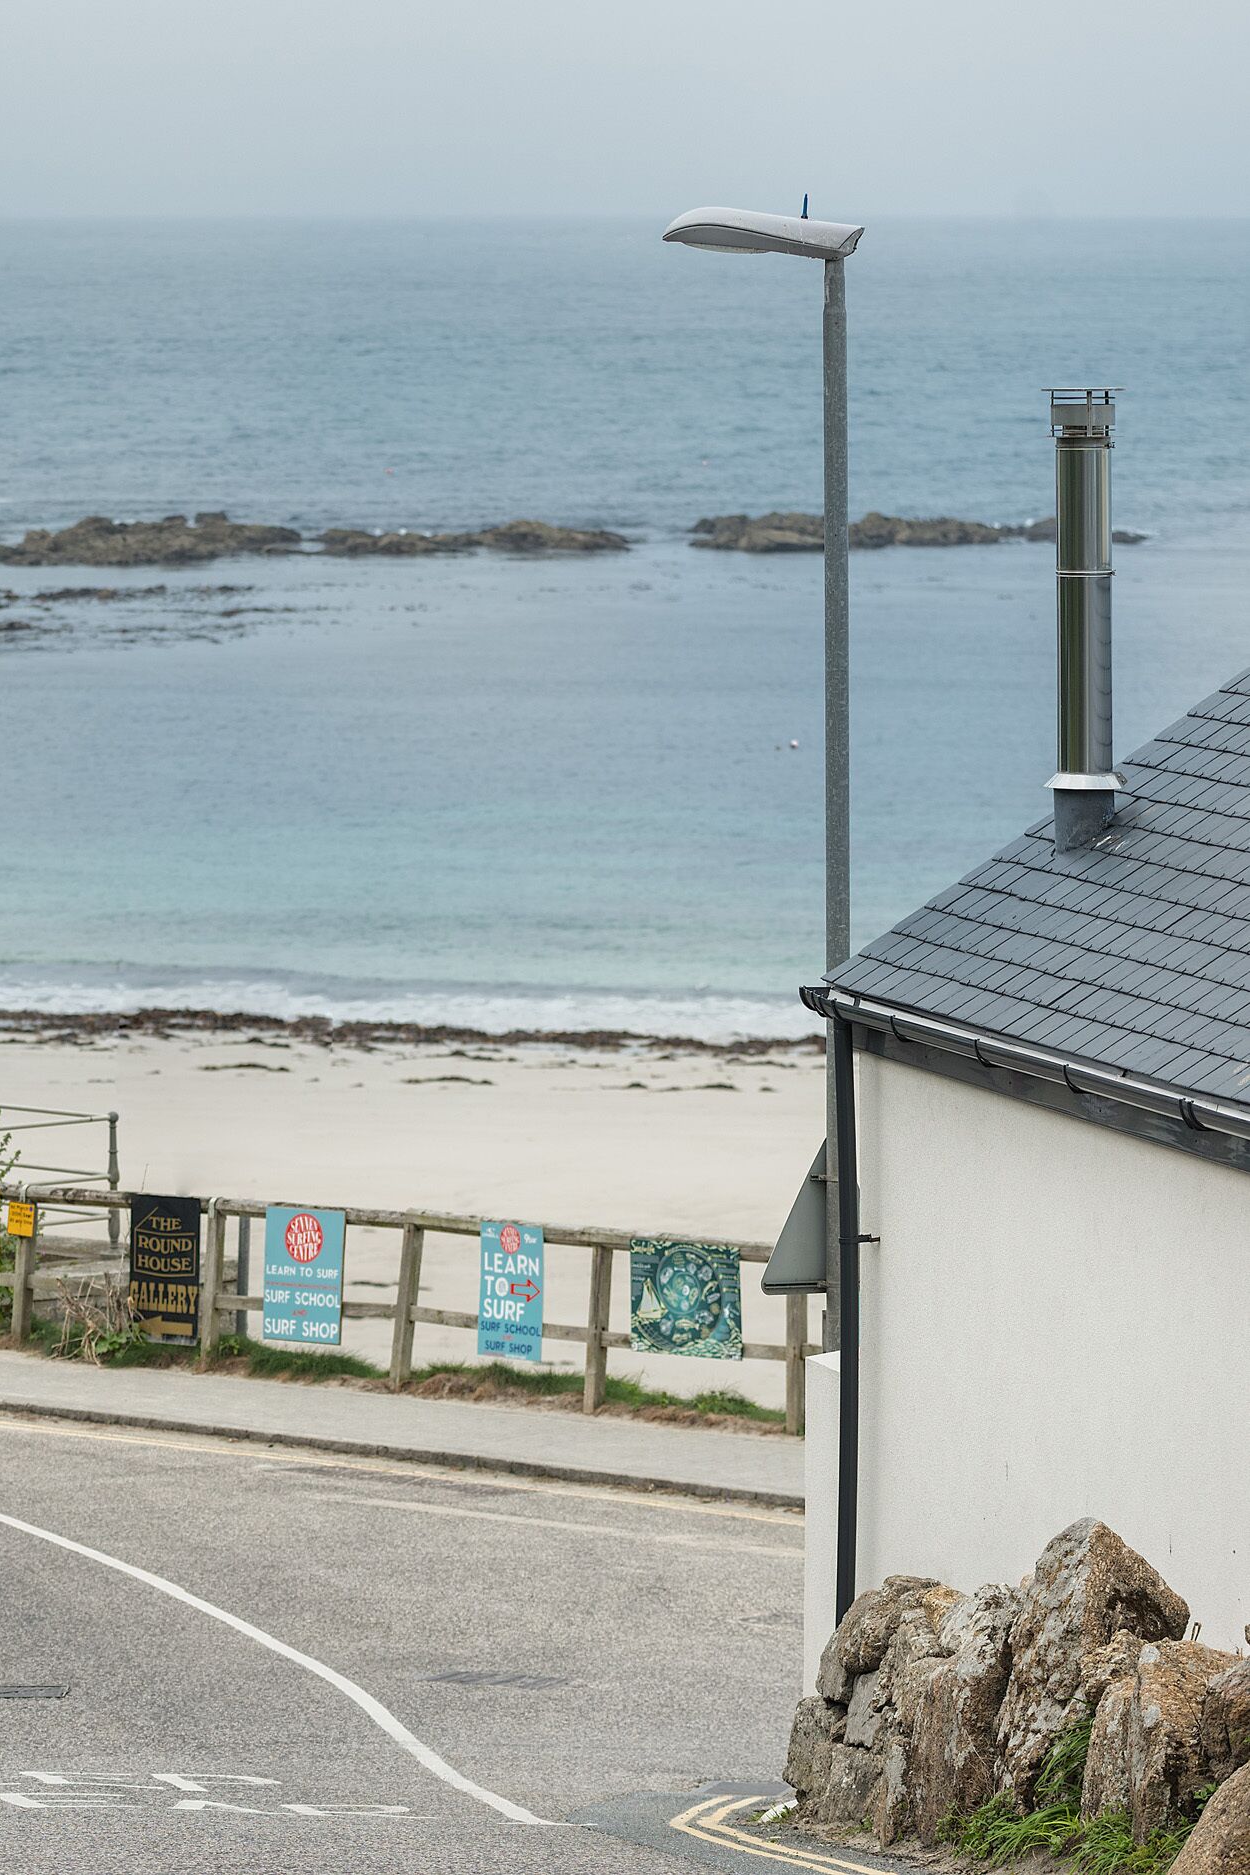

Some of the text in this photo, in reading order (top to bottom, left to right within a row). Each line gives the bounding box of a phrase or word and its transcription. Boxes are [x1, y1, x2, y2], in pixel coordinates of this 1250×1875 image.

[150, 1216, 182, 1231] THE
[137, 1234, 193, 1254] ROUND
[137, 1254, 191, 1272] HOUSE
[265, 1264, 339, 1279] LEARN TO SURF
[484, 1251, 540, 1277] LEARN
[484, 1275, 509, 1297] TO
[130, 1280, 198, 1314] GALLERY
[264, 1289, 341, 1308] SURF SCHOOL
[482, 1297, 526, 1322] SURF
[264, 1317, 339, 1339] SURF SHOP
[480, 1320, 541, 1337] SURF SCHOOL
[485, 1339, 506, 1351] SURF
[508, 1342, 533, 1355] SHOP
